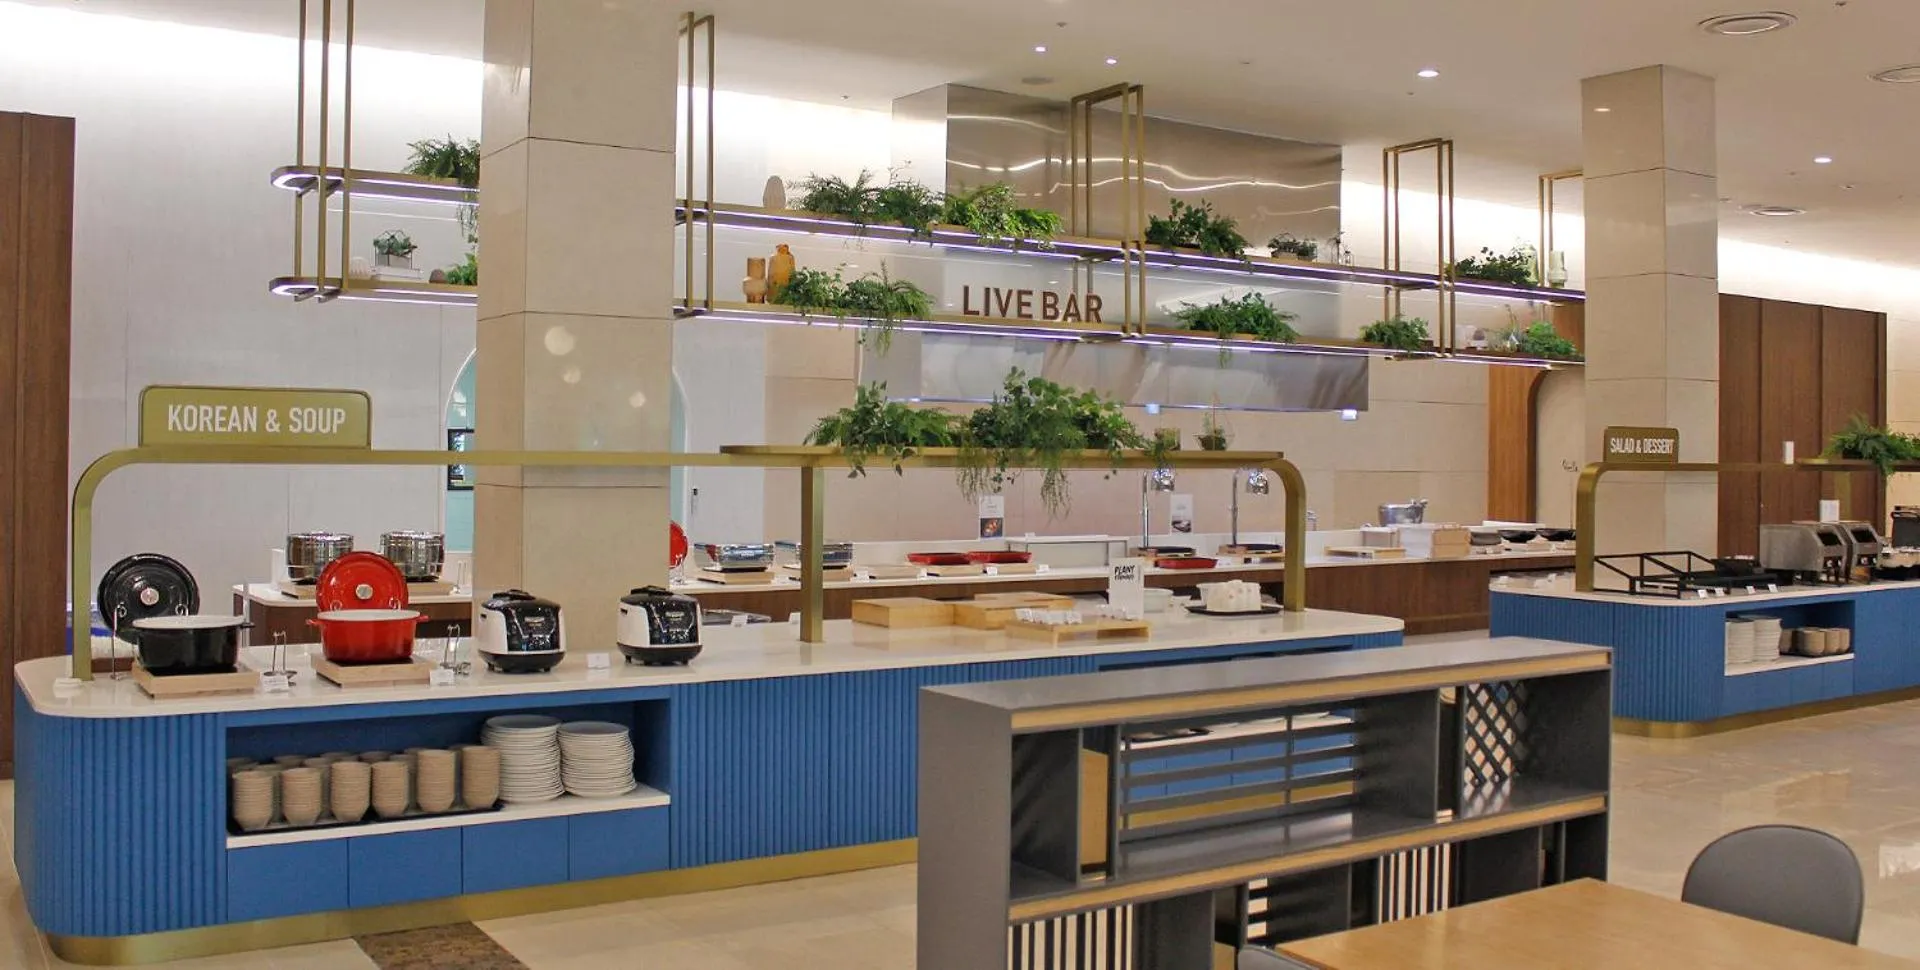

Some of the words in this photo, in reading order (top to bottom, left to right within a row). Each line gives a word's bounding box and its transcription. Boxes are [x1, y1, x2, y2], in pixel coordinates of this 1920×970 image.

[963, 286, 1033, 319] LIVE
[1042, 291, 1102, 323] BAR
[168, 404, 257, 433] KOREAN
[265, 409, 281, 433] &
[289, 407, 346, 434] SOUP
[1610, 437, 1634, 453] SALAD
[1636, 439, 1642, 453] &
[1643, 438, 1674, 453] DESSERT
